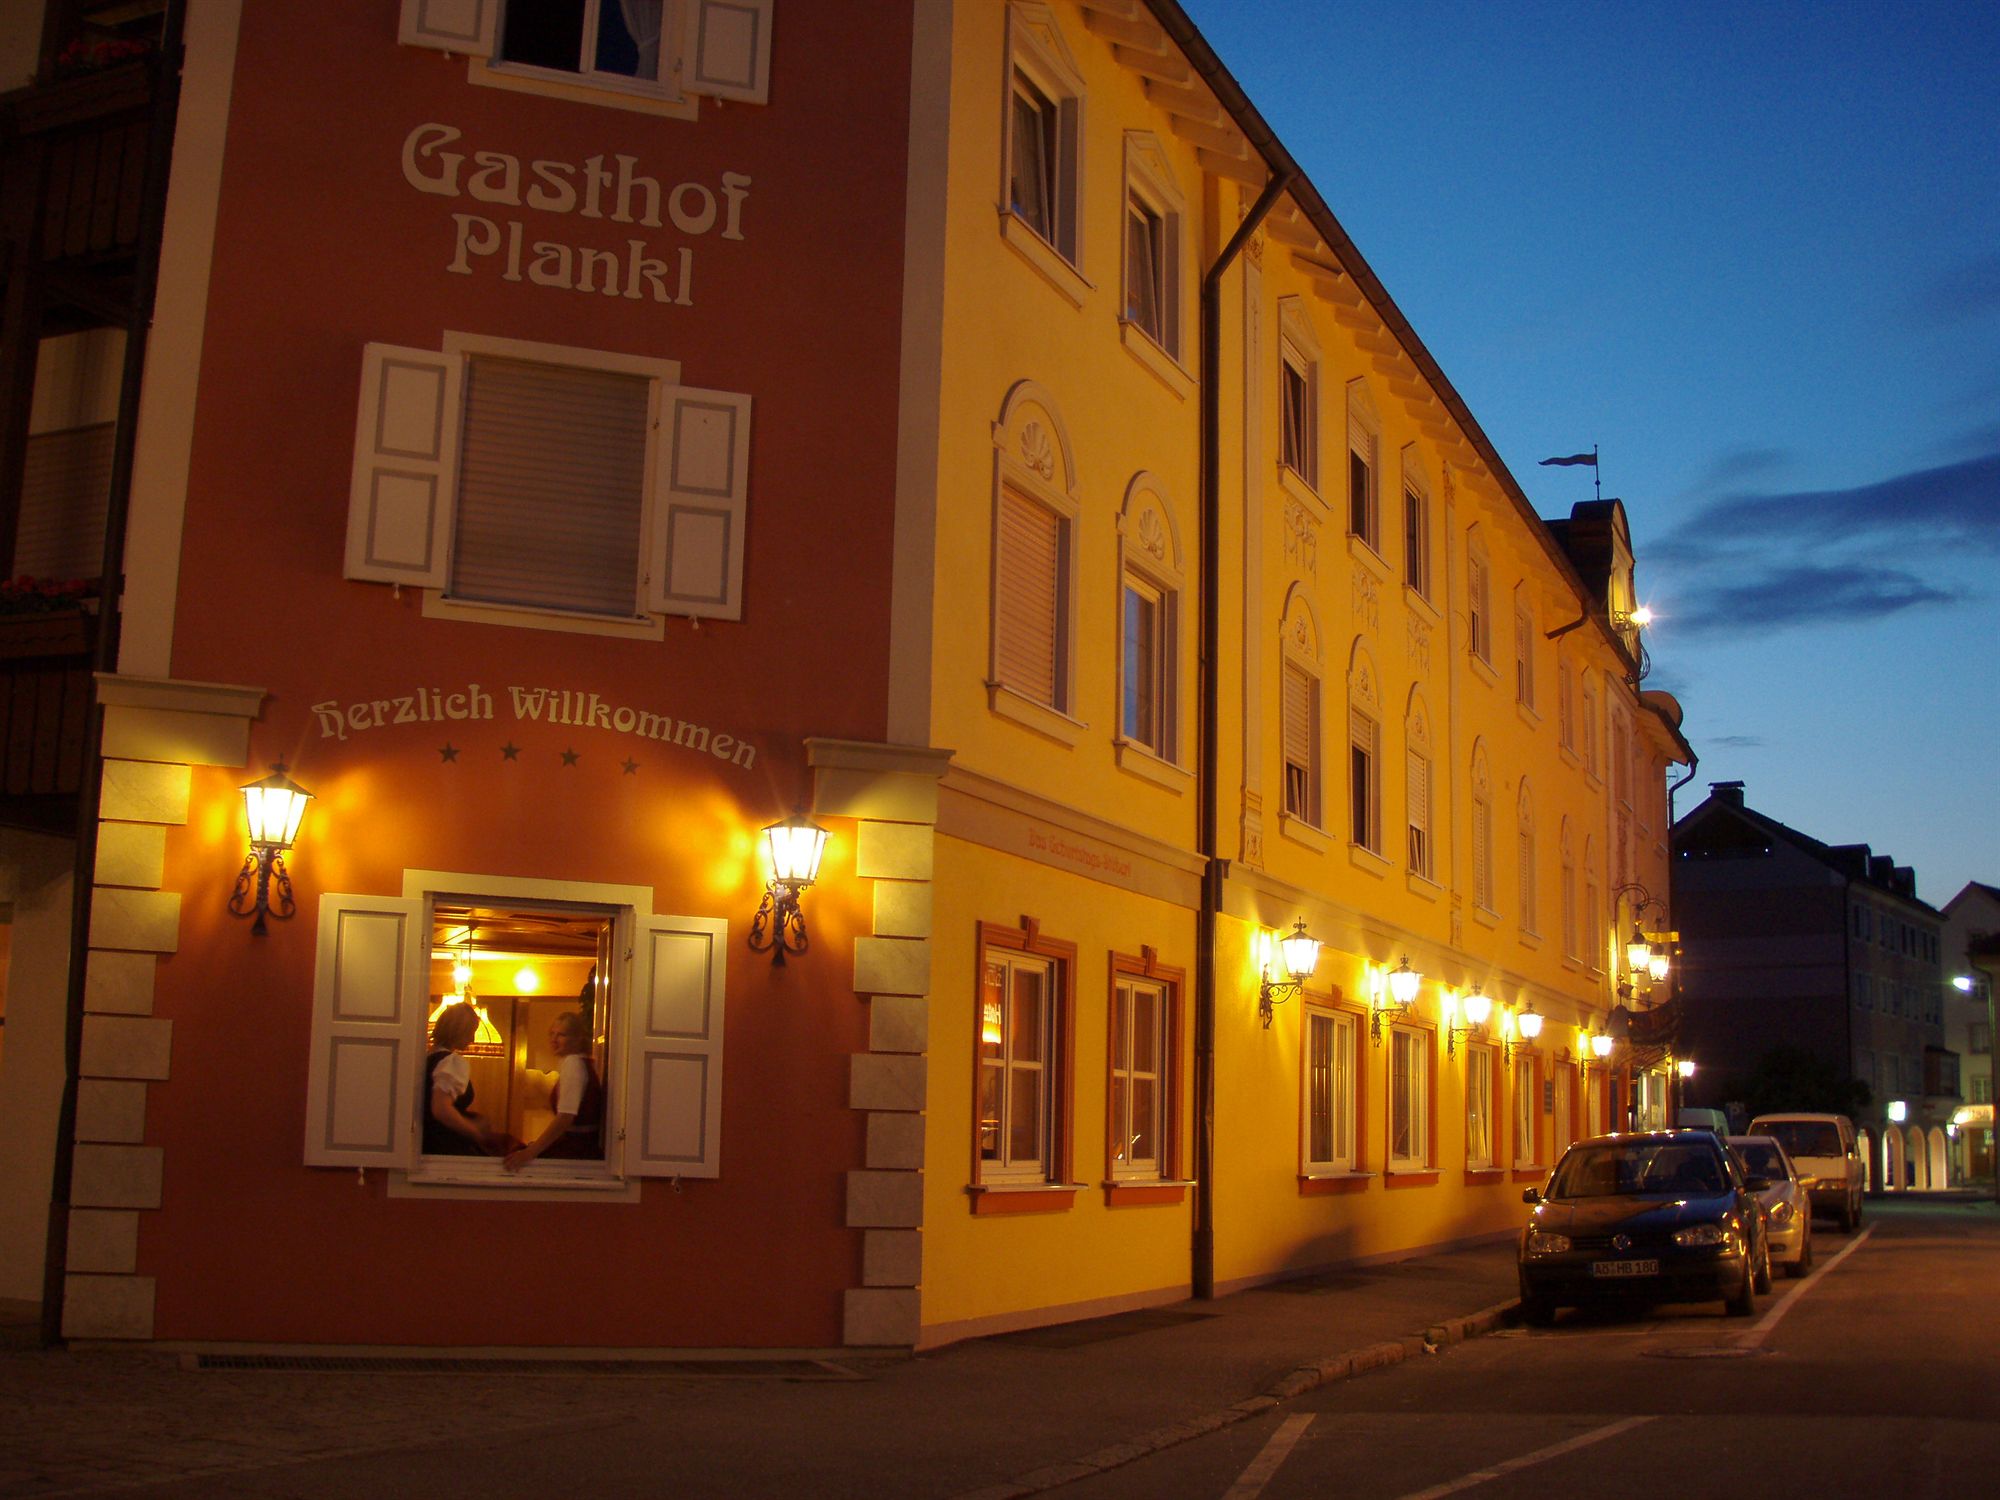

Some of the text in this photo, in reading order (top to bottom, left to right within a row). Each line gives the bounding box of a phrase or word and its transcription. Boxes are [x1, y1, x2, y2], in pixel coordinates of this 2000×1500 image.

[402, 122, 752, 241] Gasthof
[446, 213, 694, 306] Plankl
[311, 683, 757, 771] Herzlich Willkommen
